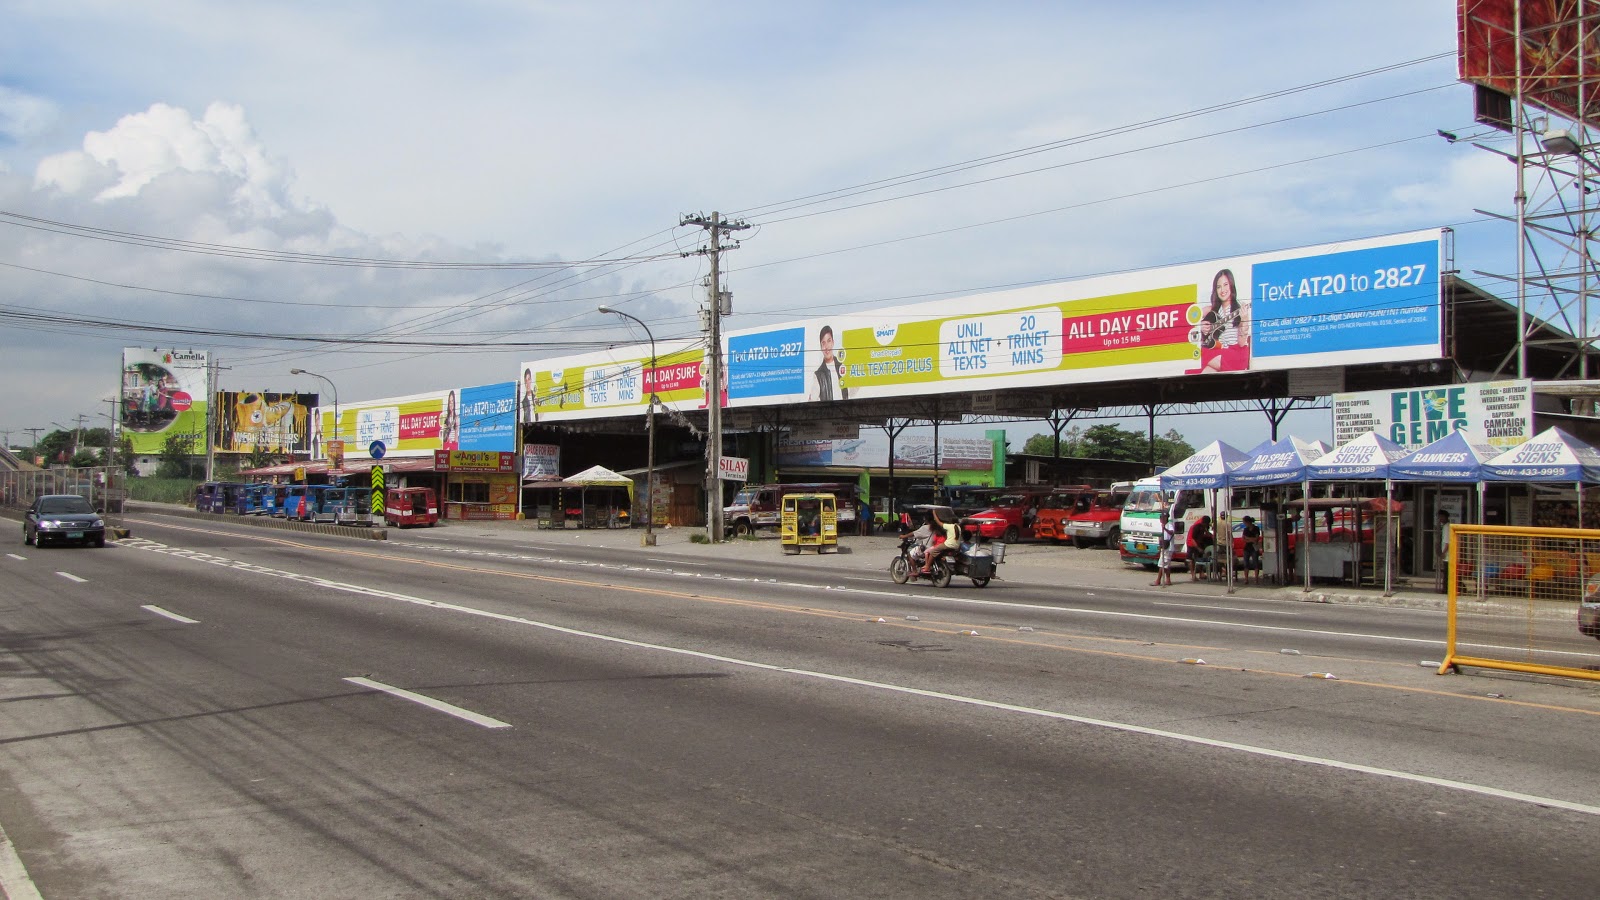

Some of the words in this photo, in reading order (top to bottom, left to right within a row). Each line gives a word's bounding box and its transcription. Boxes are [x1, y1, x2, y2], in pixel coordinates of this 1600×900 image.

[1258, 282, 1294, 303] Text
[1297, 274, 1346, 298] AT20
[1350, 274, 1369, 293] to
[1373, 264, 1427, 290] 2827
[1020, 315, 1036, 332] 20
[1068, 320, 1093, 340] ALL
[1099, 315, 1132, 337] DAY
[1136, 310, 1179, 332] SURF
[876, 329, 895, 338] SMART
[957, 322, 983, 339] UNLI
[1006, 330, 1049, 349] TRINET
[1103, 338, 1112, 347] Up
[1112, 337, 1120, 345] to
[1121, 336, 1129, 344] 15
[1130, 335, 1141, 344] MB
[731, 349, 747, 364] Text
[747, 346, 769, 361] AT20
[769, 345, 778, 359] to
[779, 341, 802, 358] 2827
[948, 341, 968, 356] ALL
[970, 337, 992, 353] NET
[173, 352, 205, 361] Camella
[1012, 348, 1044, 366] MINS
[850, 364, 866, 377] ALL
[907, 357, 933, 373] PLUS
[952, 356, 987, 371] TEXTS
[592, 368, 606, 381] UNLI
[660, 369, 675, 382] DAY
[676, 365, 696, 380] SURF
[616, 376, 637, 390] TRINET
[618, 389, 634, 401] MINS
[1479, 388, 1499, 397] SCHOOL
[1502, 386, 1527, 394] BIRTHDAY
[590, 392, 607, 404] TEXTS
[1350, 399, 1370, 407] COPYING
[1481, 395, 1505, 404] WEDDING
[1508, 394, 1526, 402] FIESTA
[473, 400, 489, 416] AT20
[496, 398, 514, 413] 2827
[1390, 387, 1466, 423] FIVE
[1486, 403, 1520, 412] ANNIVERSARY
[1492, 411, 1515, 419] BAPTISM
[400, 417, 412, 432] ALL
[411, 415, 422, 429] DAY
[422, 412, 438, 427] SURF
[1484, 417, 1526, 430] CAMPAIGN
[1487, 427, 1523, 438] BANNERS
[1338, 445, 1377, 454] LIGHTED
[1522, 442, 1564, 453] INDOOR
[459, 451, 490, 462] Angel's
[1188, 454, 1220, 463] QUALITY
[1253, 454, 1269, 464] AD
[1268, 452, 1297, 463] SPACE
[1332, 453, 1370, 464] SIGNS
[1411, 451, 1468, 463] BANNERS
[1512, 451, 1562, 464] SIGNS
[719, 458, 747, 473] SILAY
[1181, 462, 1213, 474] SIGNS
[1250, 460, 1294, 472] AVAILABLE
[1318, 467, 1336, 475] call:
[1338, 465, 1376, 474] 433-9999
[725, 471, 747, 480] Terminal
[1495, 468, 1517, 476] call:
[1519, 467, 1566, 477] 433-9999
[1186, 477, 1216, 485] 433-9999
